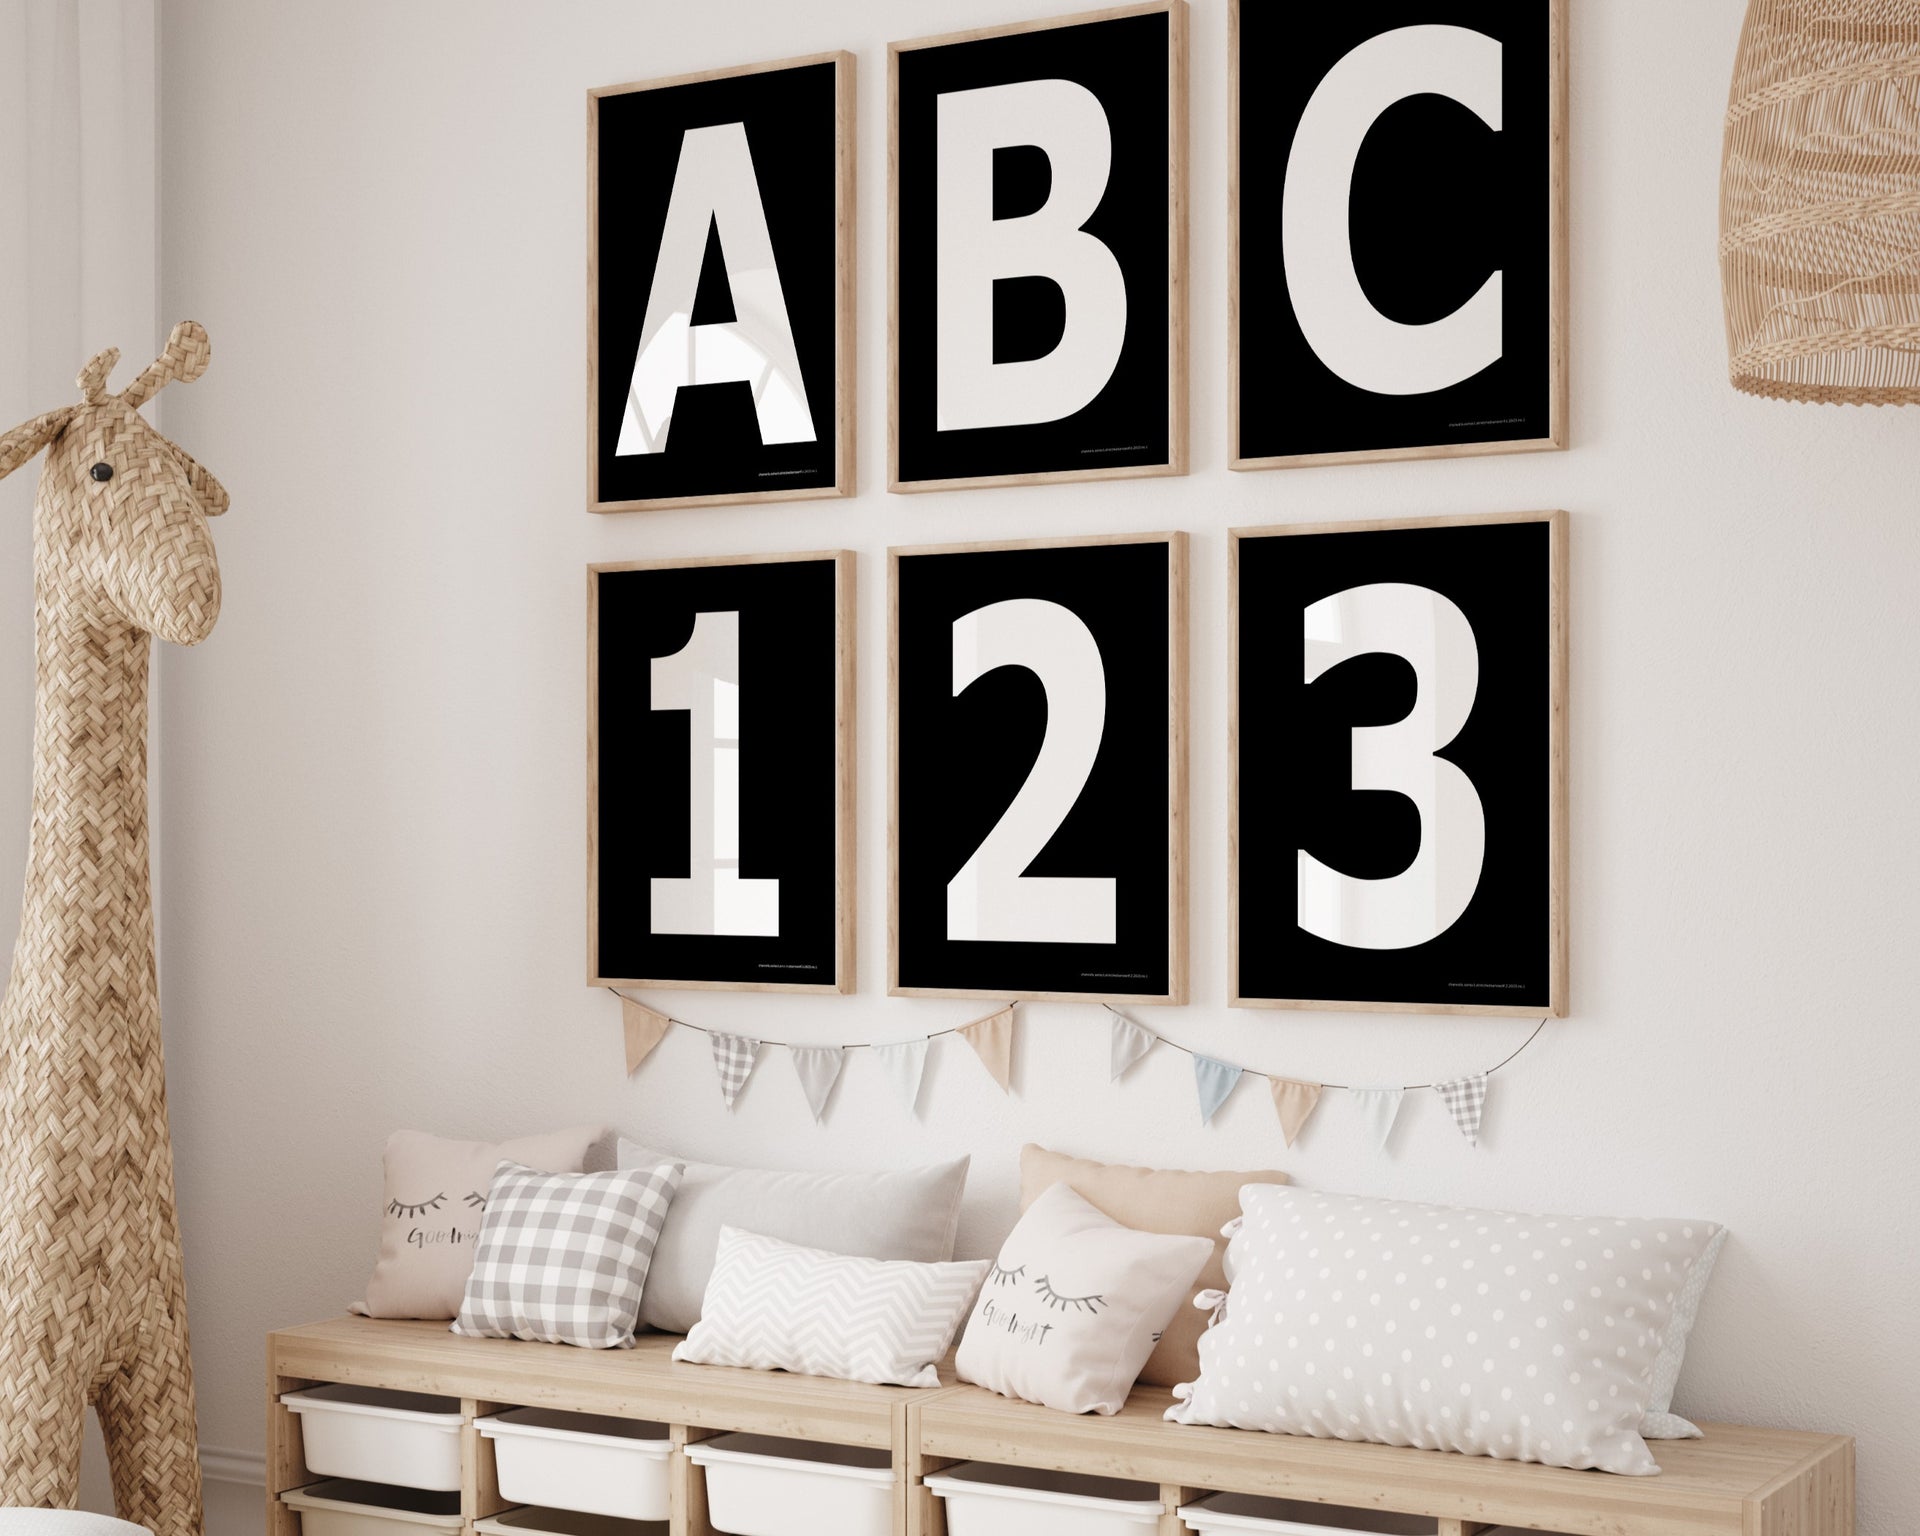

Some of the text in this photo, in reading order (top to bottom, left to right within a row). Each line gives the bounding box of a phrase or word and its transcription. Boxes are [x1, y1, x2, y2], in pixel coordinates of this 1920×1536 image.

[615, 122, 817, 456] A
[937, 79, 1127, 431] B
[1282, 25, 1502, 395] C
[651, 611, 779, 937] 1
[947, 599, 1116, 944] 2
[1298, 583, 1485, 949] 3
